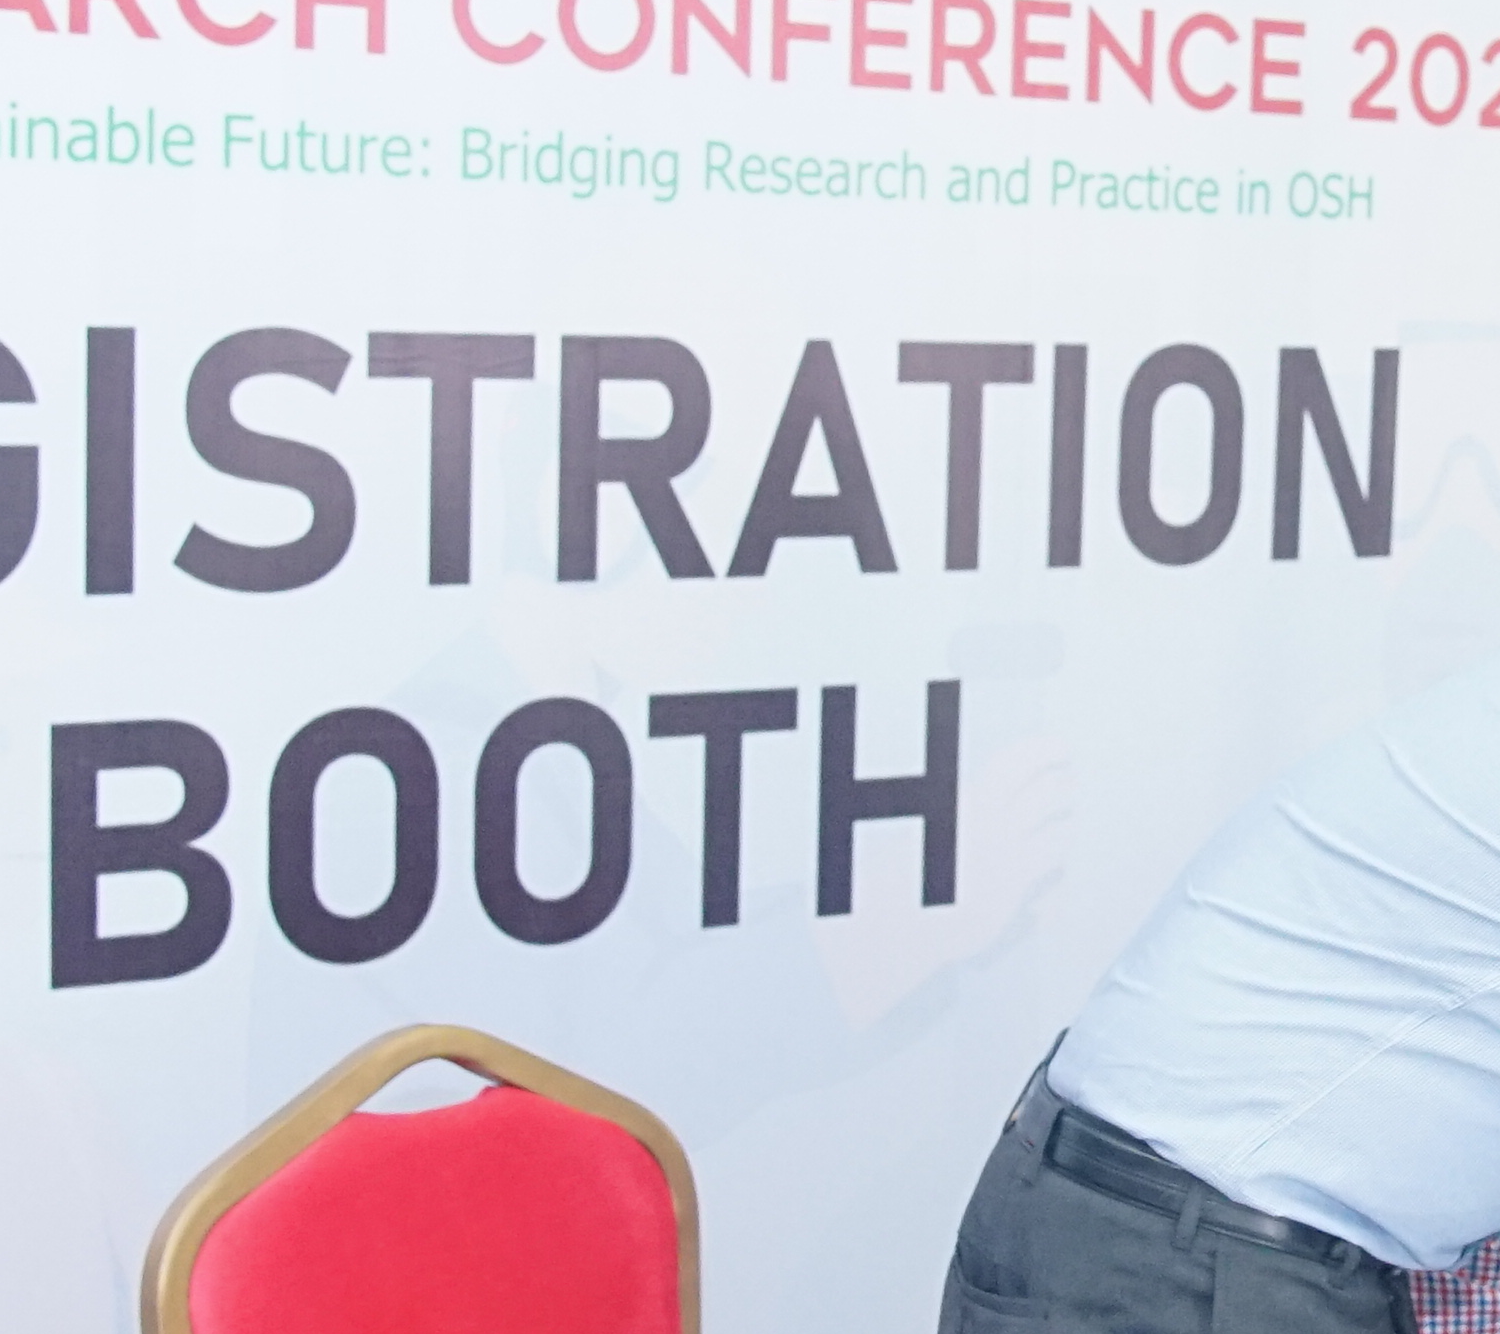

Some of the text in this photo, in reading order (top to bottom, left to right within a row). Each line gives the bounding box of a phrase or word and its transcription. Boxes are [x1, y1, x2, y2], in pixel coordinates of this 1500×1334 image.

[219, 113, 434, 180] Future:
[459, 126, 681, 203] Bridging
[702, 138, 928, 204] Research
[946, 154, 1031, 208] and
[1050, 158, 1221, 218] Practice
[1236, 166, 1272, 218] in
[1286, 169, 1376, 222] OSH
[49, 679, 963, 990] BOOTH
